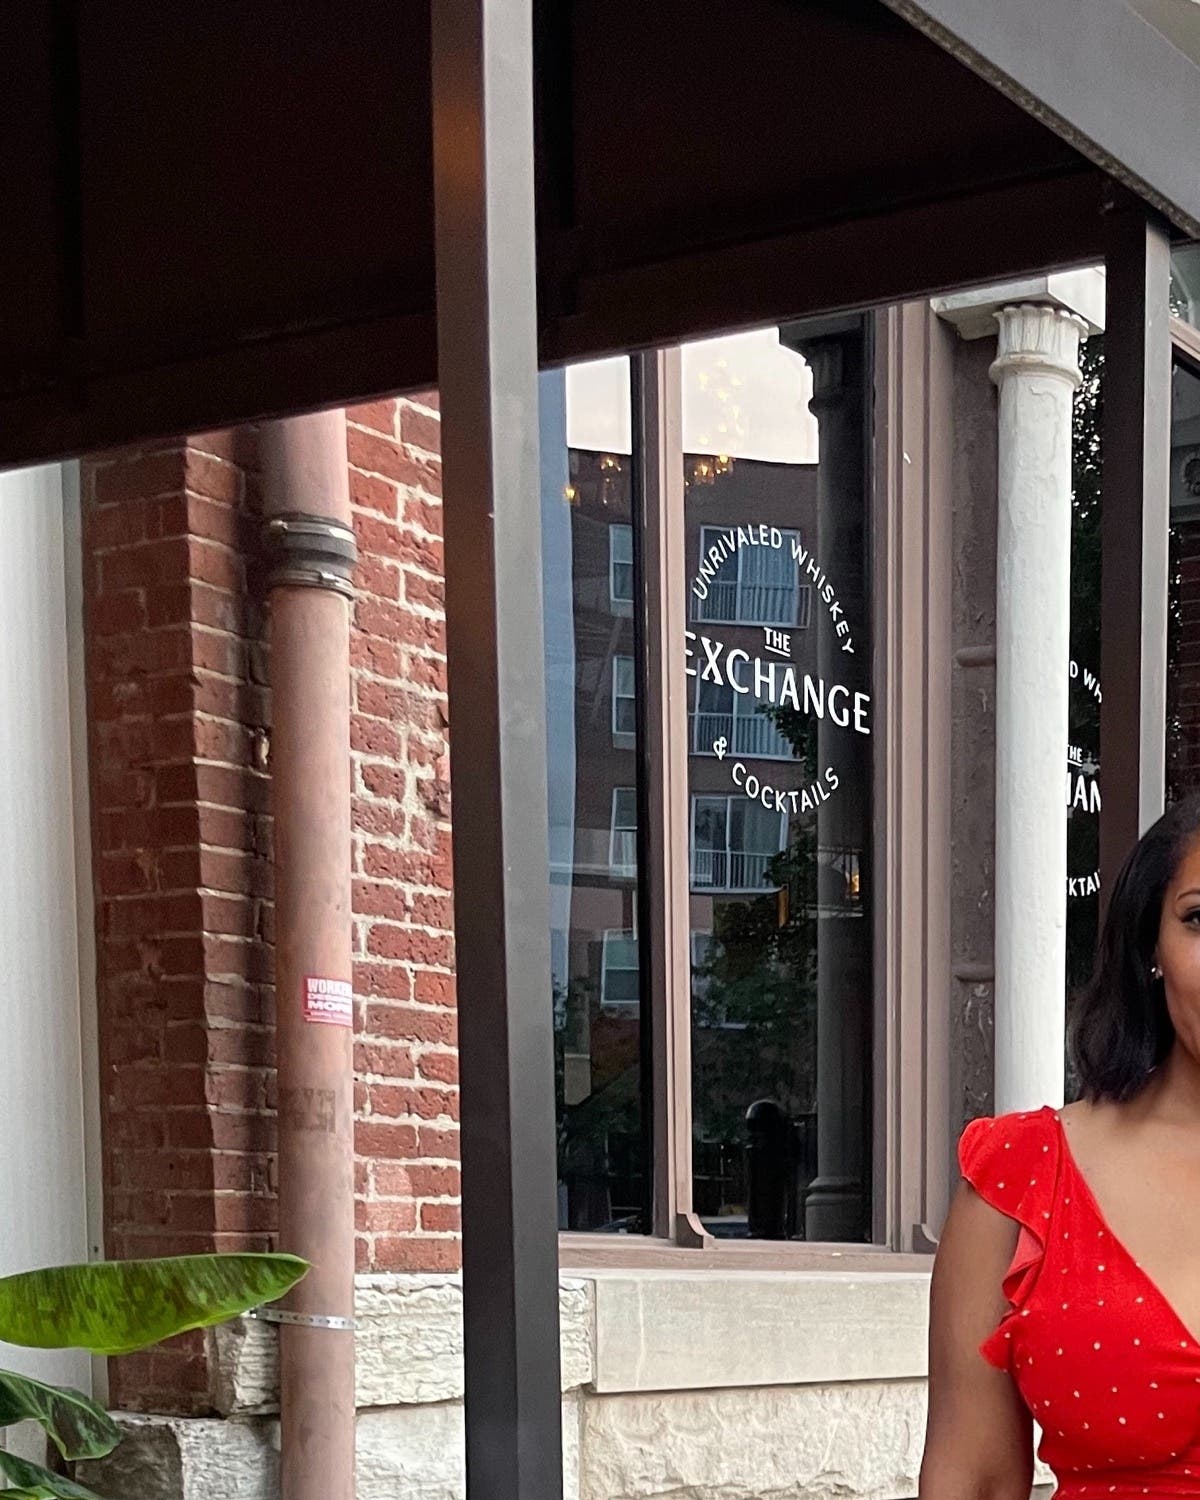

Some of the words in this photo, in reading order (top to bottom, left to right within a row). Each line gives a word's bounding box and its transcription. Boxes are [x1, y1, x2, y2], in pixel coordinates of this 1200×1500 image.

[692, 523, 783, 601] UNRIVALED
[790, 538, 855, 655] WHISKEY
[763, 626, 792, 654] THE
[712, 736, 728, 761] &
[731, 762, 840, 814] COCKTAILS
